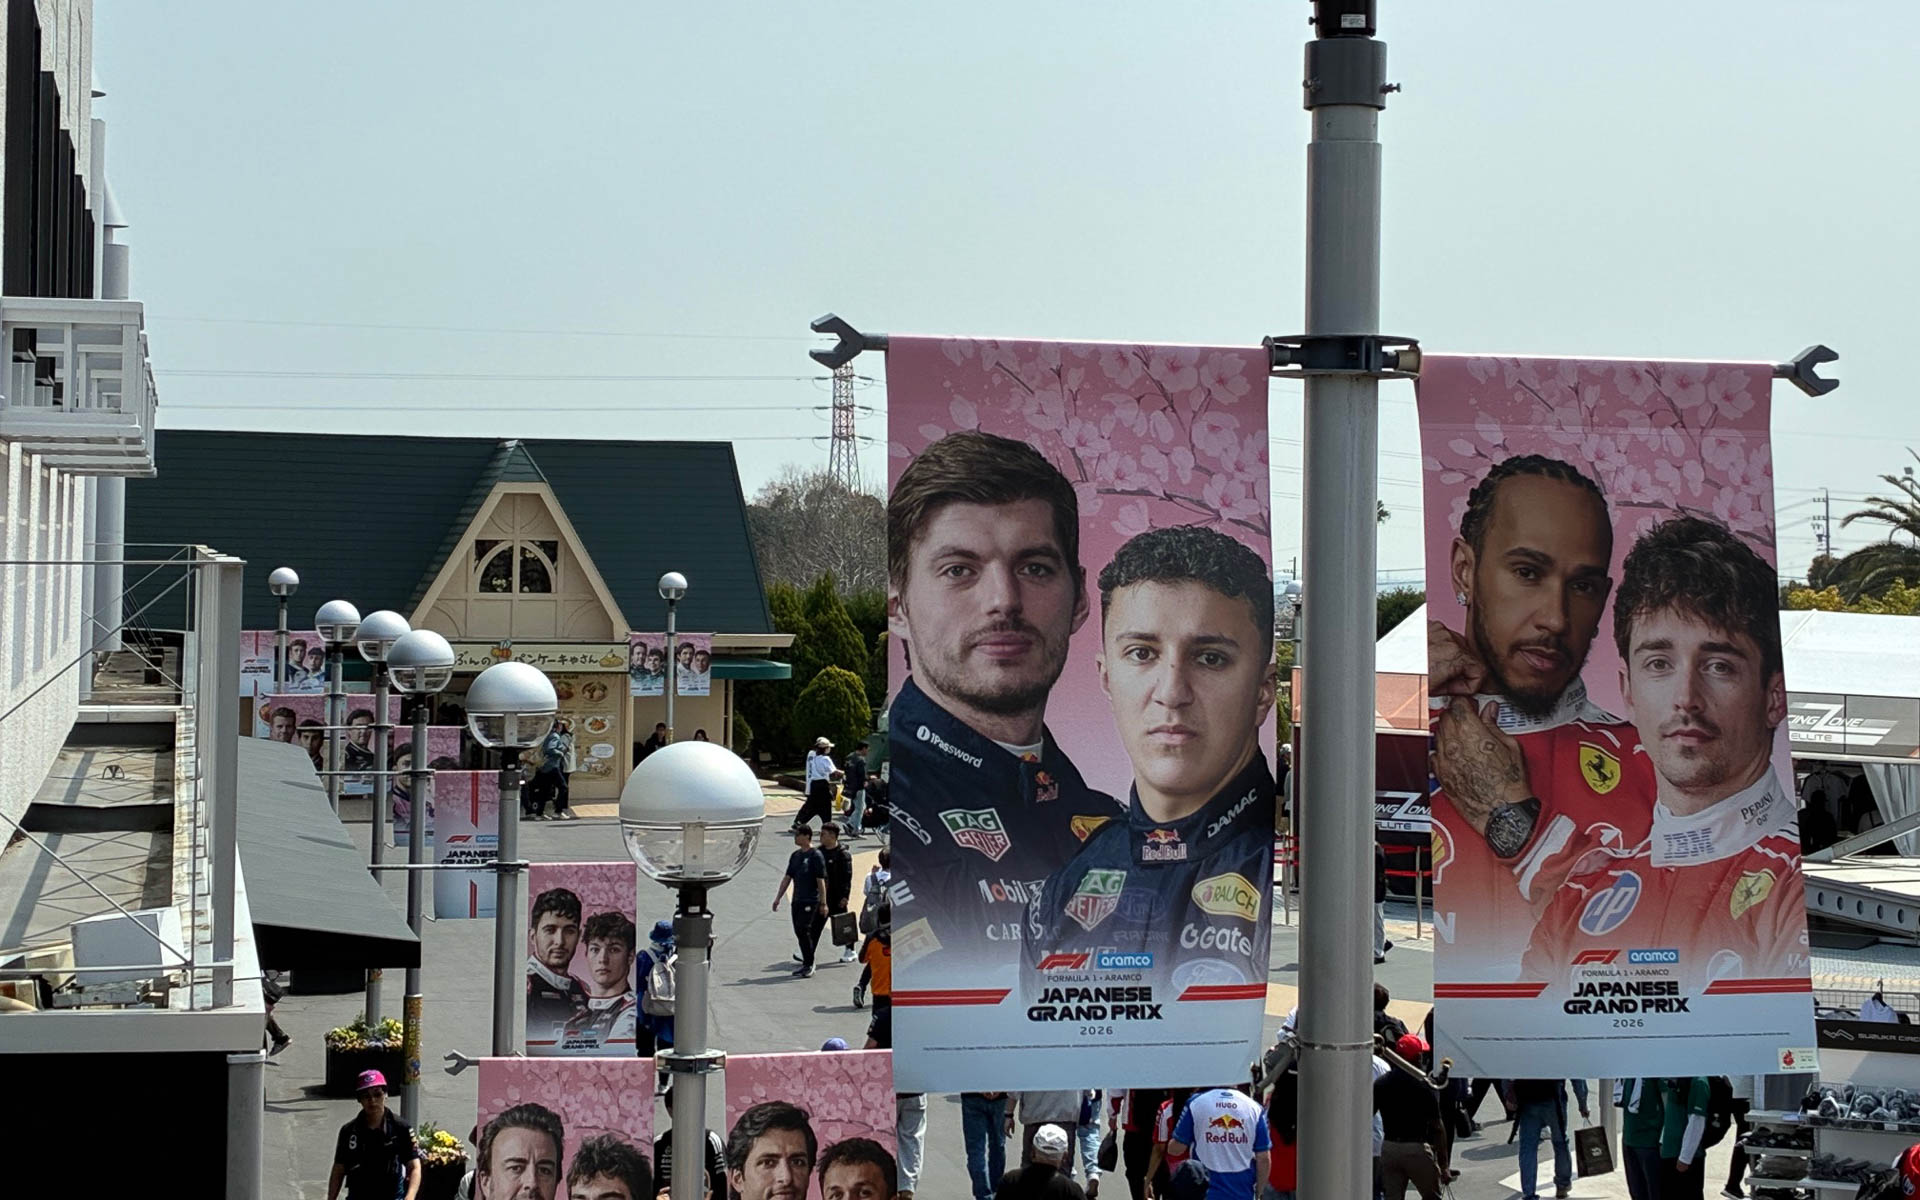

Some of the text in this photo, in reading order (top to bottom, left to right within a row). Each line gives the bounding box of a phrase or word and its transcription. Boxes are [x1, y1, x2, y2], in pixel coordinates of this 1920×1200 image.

[454, 651, 491, 666] ぶんの
[1790, 732, 1833, 741] ELLITE
[931, 733, 984, 769] 1Password
[1207, 788, 1258, 838] DAMAC
[888, 802, 932, 845] arco
[947, 813, 998, 830] TAG
[1376, 821, 1412, 830] LLITE
[958, 831, 1006, 857] HEUER
[1663, 828, 1714, 858] IBM
[1084, 875, 1121, 893] AG
[1213, 884, 1258, 915] RAUCH
[1101, 956, 1150, 967] aramco
[1630, 951, 1676, 962] aramco
[1048, 974, 1090, 982] FORMULA
[1105, 974, 1142, 982] ARAMCO
[1582, 969, 1621, 977] FORMULA
[1635, 968, 1669, 976] ARAMCO
[1038, 987, 1153, 1003] JAPANESE
[1573, 981, 1679, 997] JAPANESE
[1027, 1004, 1164, 1022] GRAND PRIX
[1564, 997, 1690, 1015] GRAND PRIX
[1080, 1026, 1113, 1035] 2026
[1613, 1019, 1644, 1028] 2026
[1215, 1102, 1238, 1110] HUGO
[1206, 1132, 1248, 1145] Red Bull
